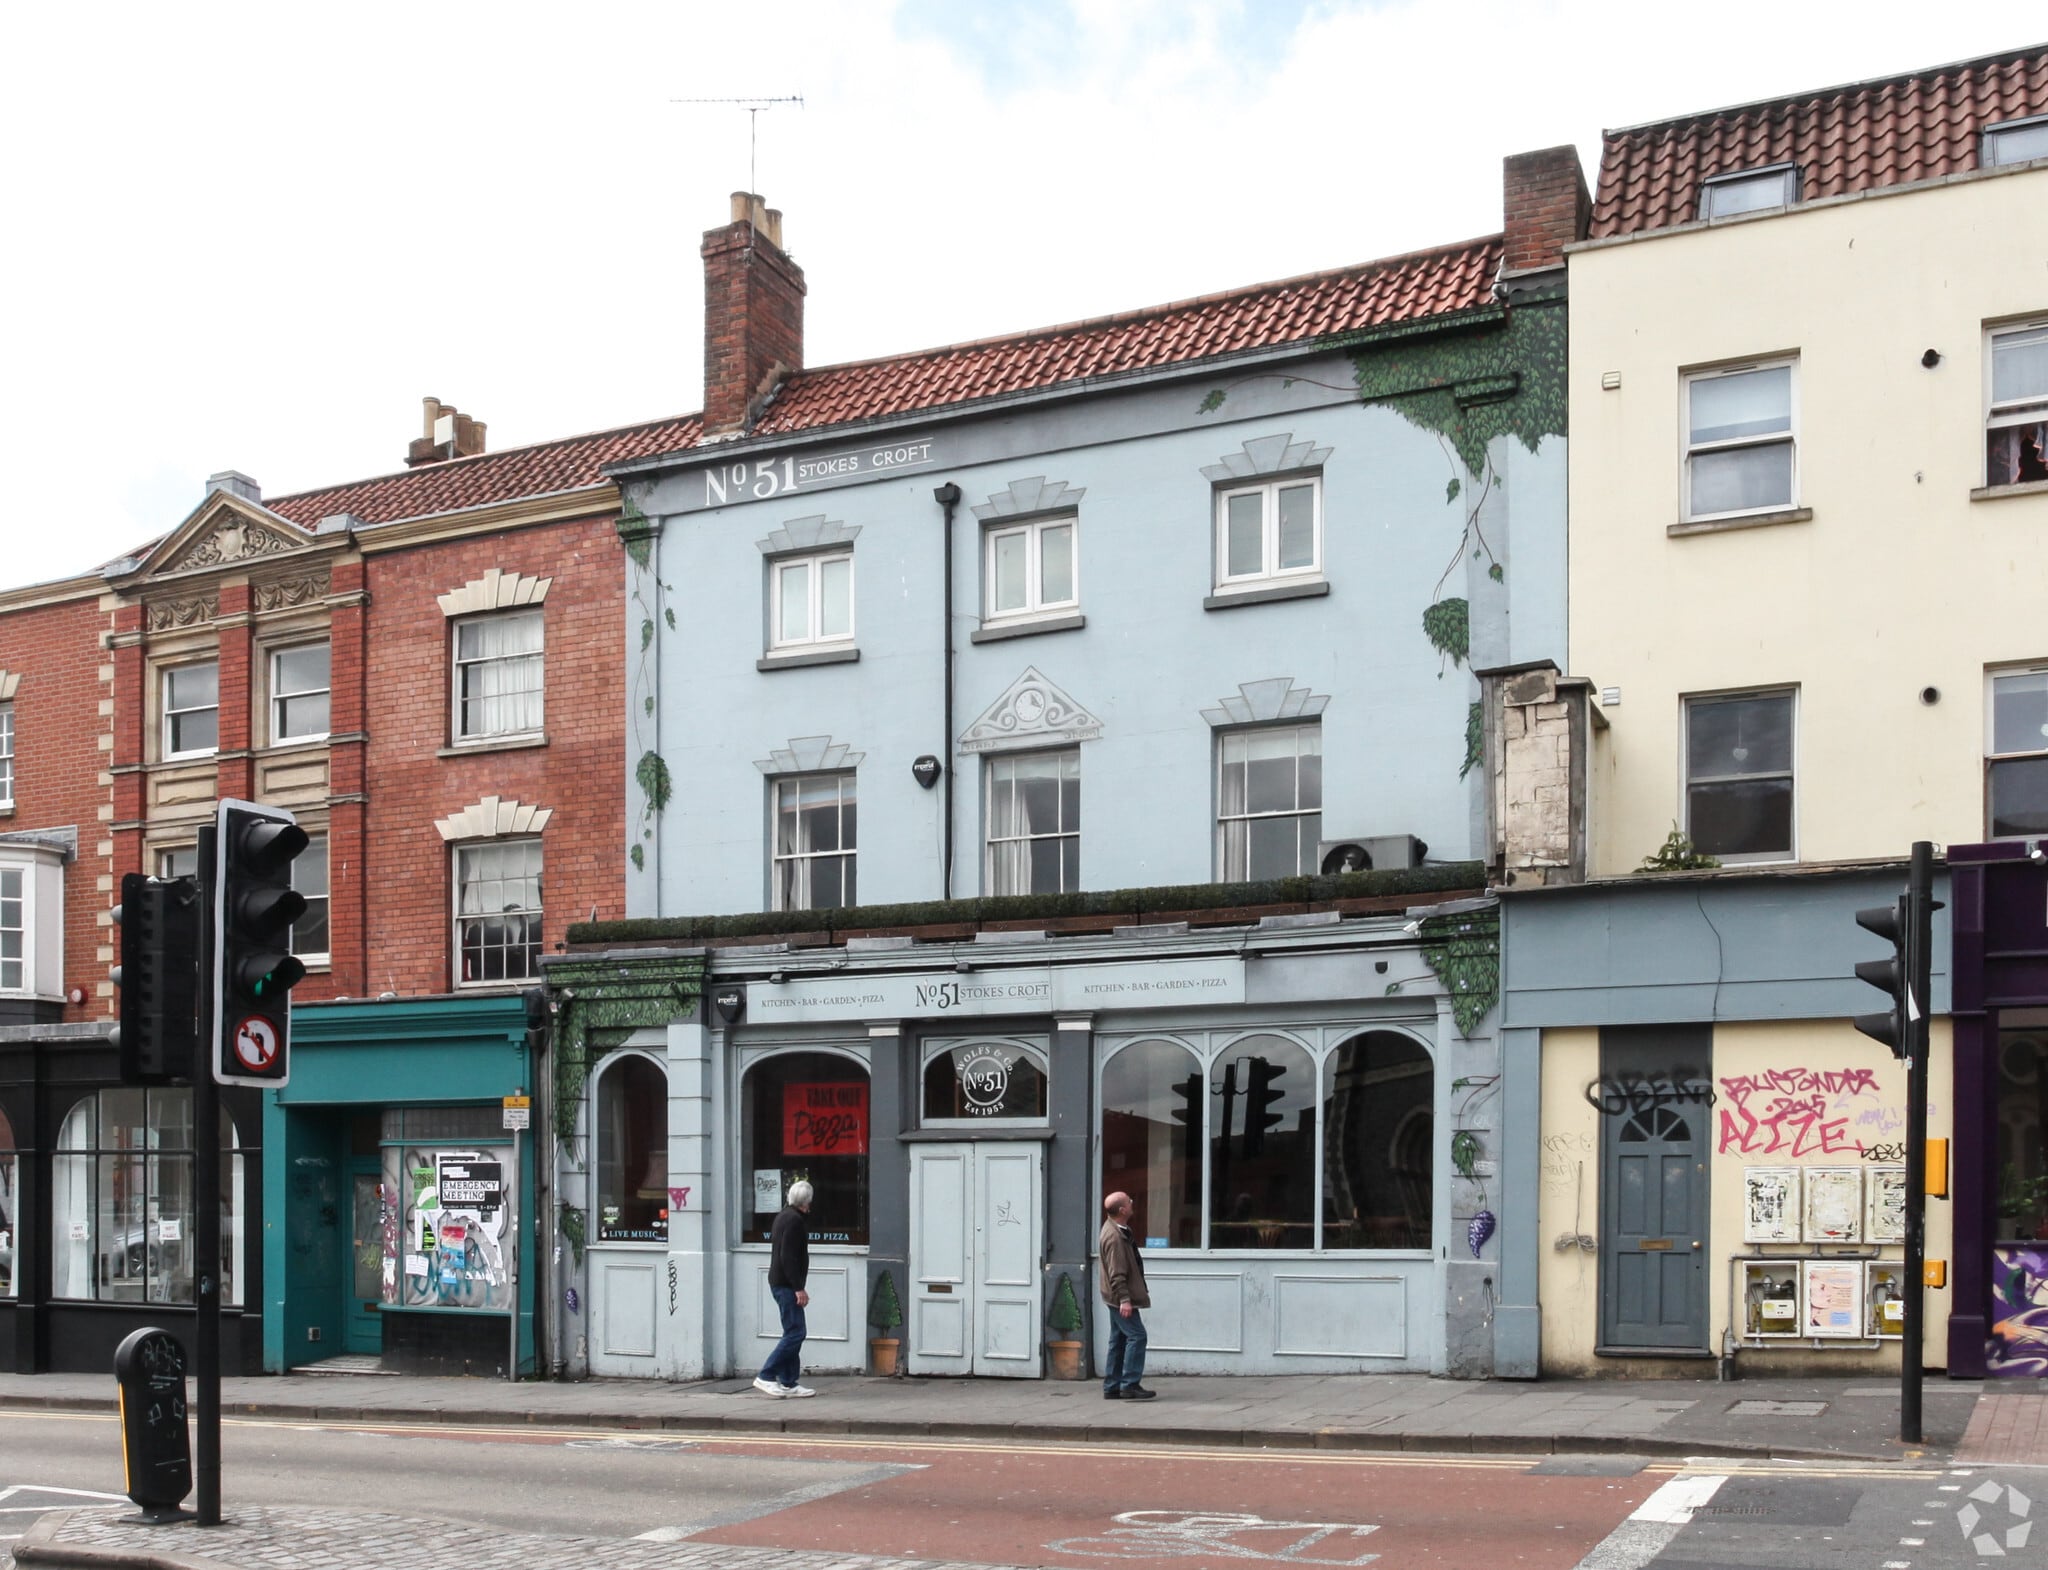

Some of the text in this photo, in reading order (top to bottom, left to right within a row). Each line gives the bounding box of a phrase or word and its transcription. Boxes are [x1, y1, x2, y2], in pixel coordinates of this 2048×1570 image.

[799, 456, 858, 478] STOKES
[872, 444, 931, 467] CROFT
[960, 987, 1003, 999] STOKES
[1008, 984, 1049, 996] CROFT
[1084, 978, 1227, 993] KITCHEN BAR GARDEN PIZZA
[761, 994, 885, 1008] KITCHEN BAR GARDEN PIZZA
[957, 1046, 991, 1071] WOLFS
[793, 1109, 858, 1150] Pizza
[442, 1180, 497, 1190] EMERGENCY
[756, 1175, 778, 1191] Pizza
[442, 1190, 485, 1200] MEETING
[609, 1230, 658, 1238] LIVE MUSIC
[823, 1232, 850, 1241] PIZZA
